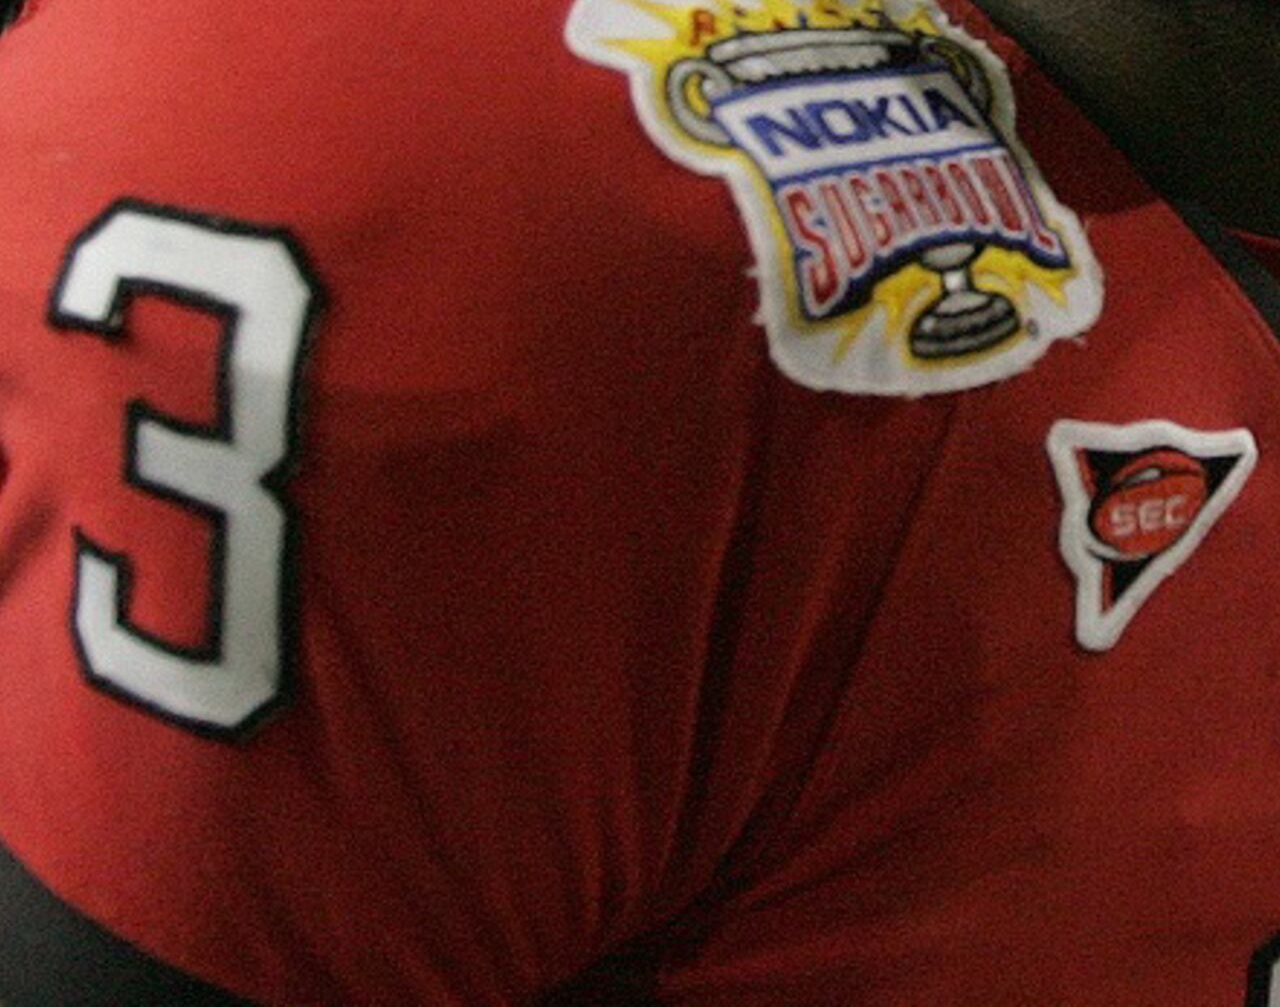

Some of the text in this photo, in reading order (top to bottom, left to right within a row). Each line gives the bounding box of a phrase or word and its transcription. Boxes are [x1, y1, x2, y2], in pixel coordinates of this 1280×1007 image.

[744, 86, 978, 157] NOKIA
[46, 198, 324, 724] 3
[1110, 493, 1187, 537] SEC
